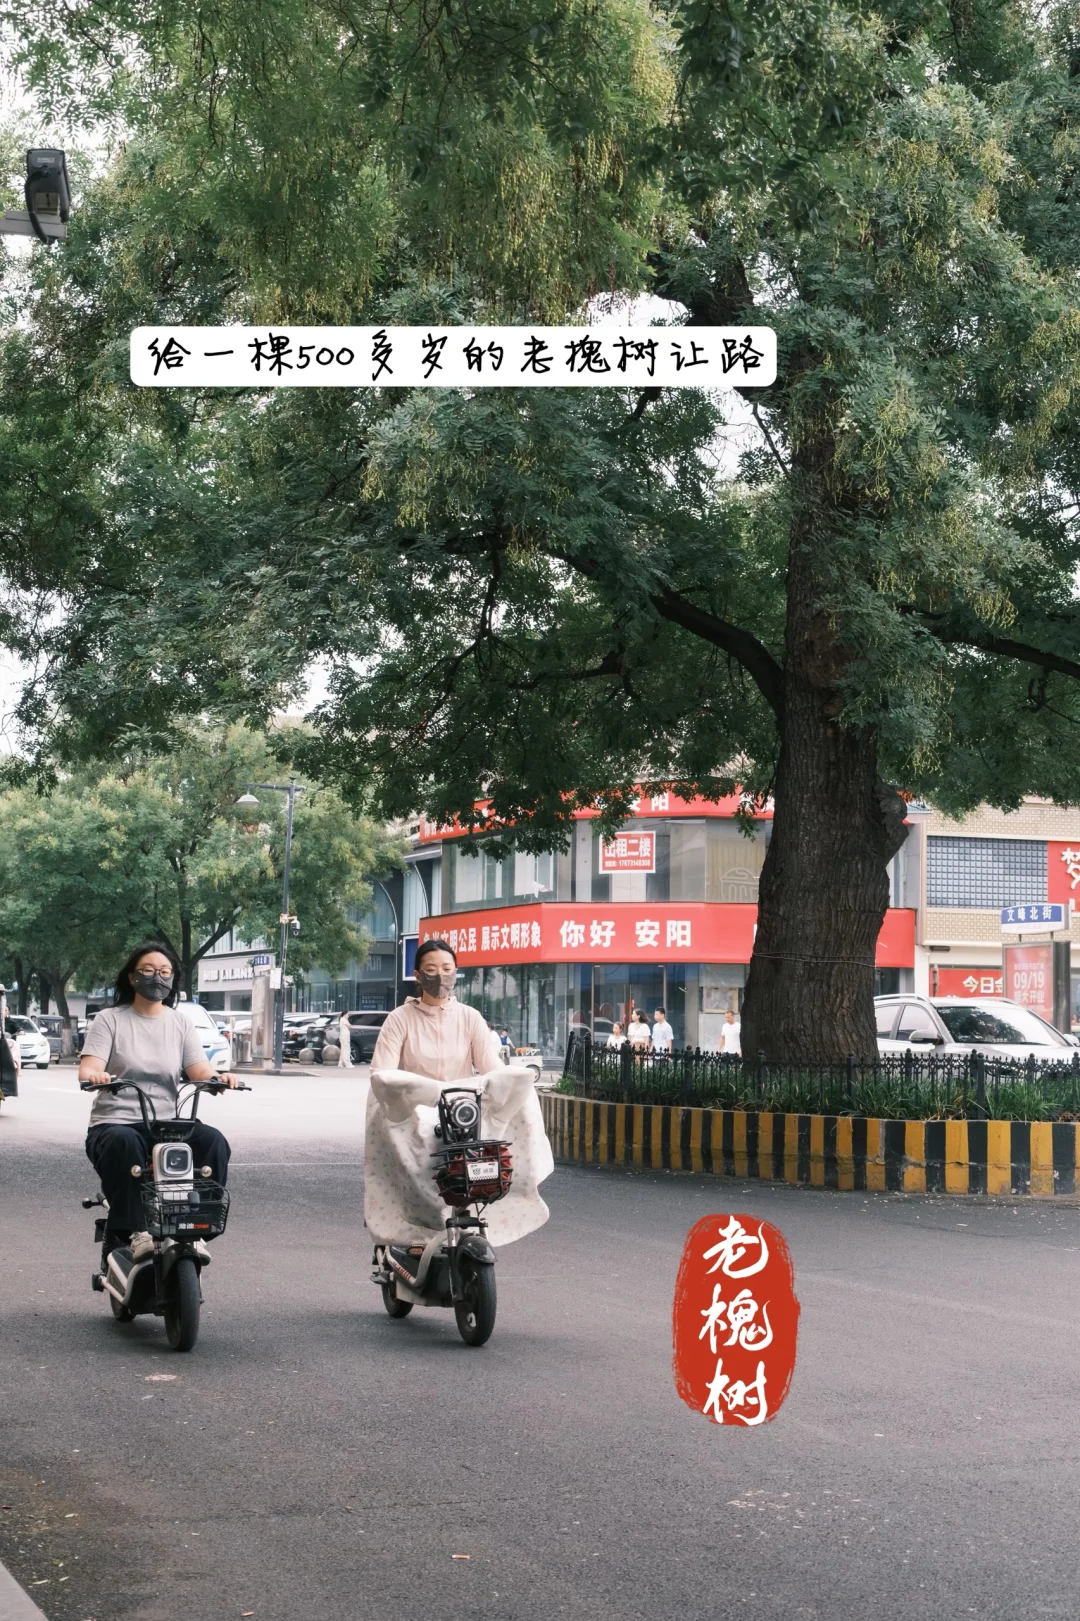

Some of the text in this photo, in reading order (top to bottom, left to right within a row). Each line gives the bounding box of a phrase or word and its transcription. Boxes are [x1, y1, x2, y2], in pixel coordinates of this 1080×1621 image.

[604, 837, 651, 858] 出租二楼
[1007, 905, 1053, 922] 文峰北街
[481, 920, 541, 951] 展示文明形象
[560, 919, 692, 948] 你好 安阳
[1013, 970, 1045, 989] 09/19
